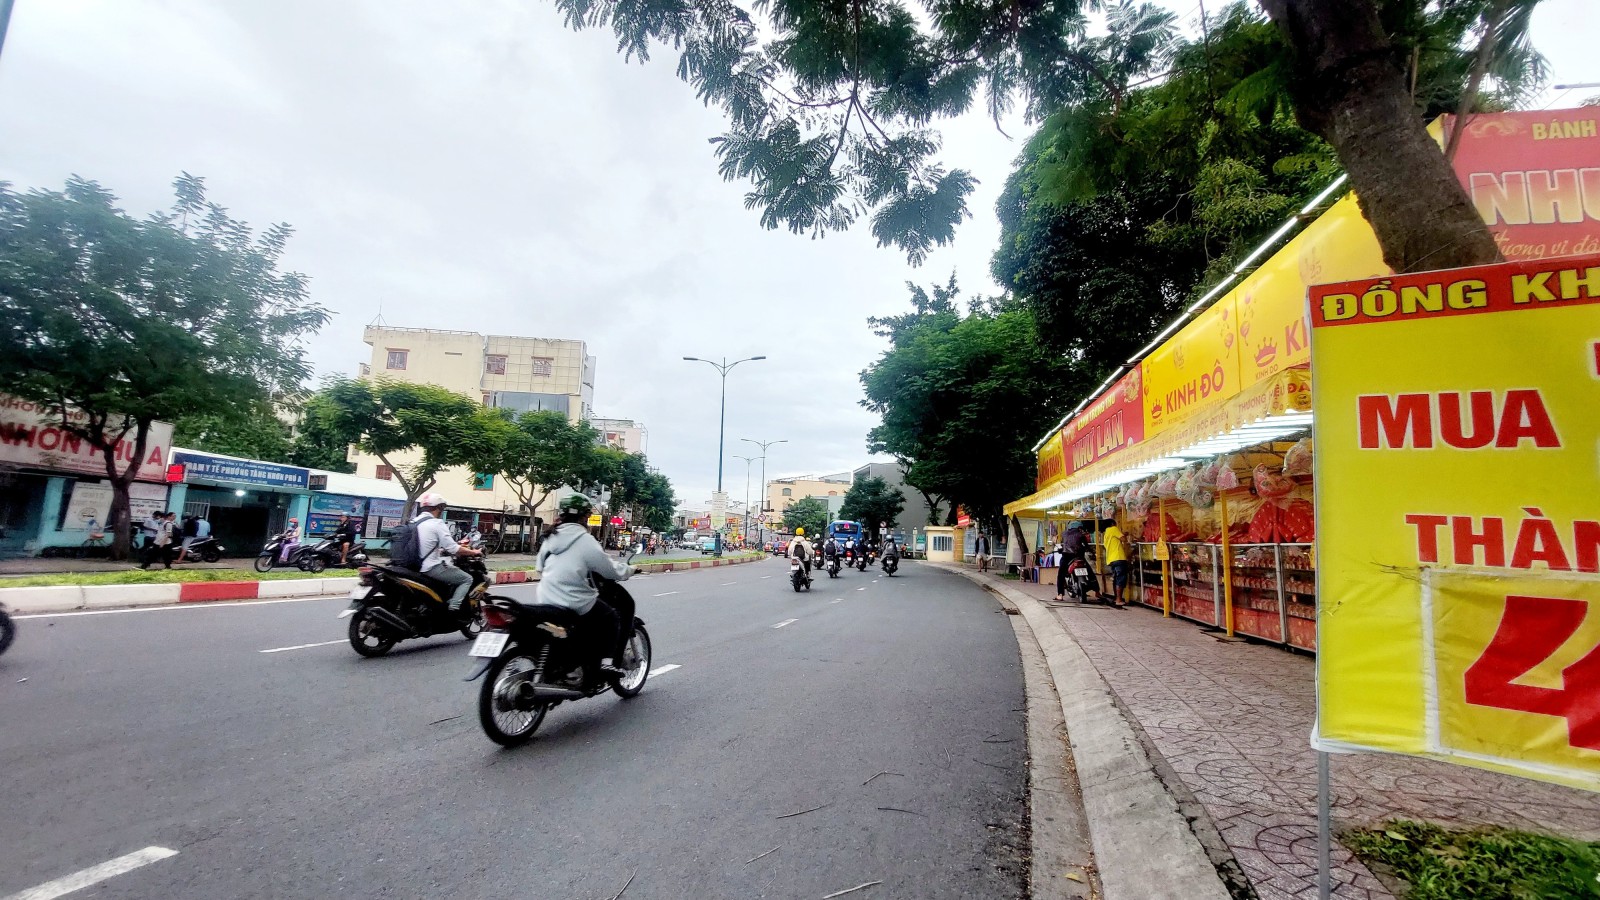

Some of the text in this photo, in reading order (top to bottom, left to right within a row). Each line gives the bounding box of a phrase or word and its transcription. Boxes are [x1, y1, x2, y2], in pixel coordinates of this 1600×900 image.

[1532, 118, 1597, 140] BÁNH
[1321, 266, 1600, 321] ĐỒNG KH
[1166, 379, 1197, 415] KINH
[1199, 358, 1225, 399] ĐÔ
[1072, 426, 1095, 471] NHƯ
[1096, 409, 1124, 458] LAN
[1358, 389, 1561, 449] MUA
[146, 446, 162, 466] A
[184, 461, 205, 473] TRẠM
[212, 464, 220, 473] TẾ
